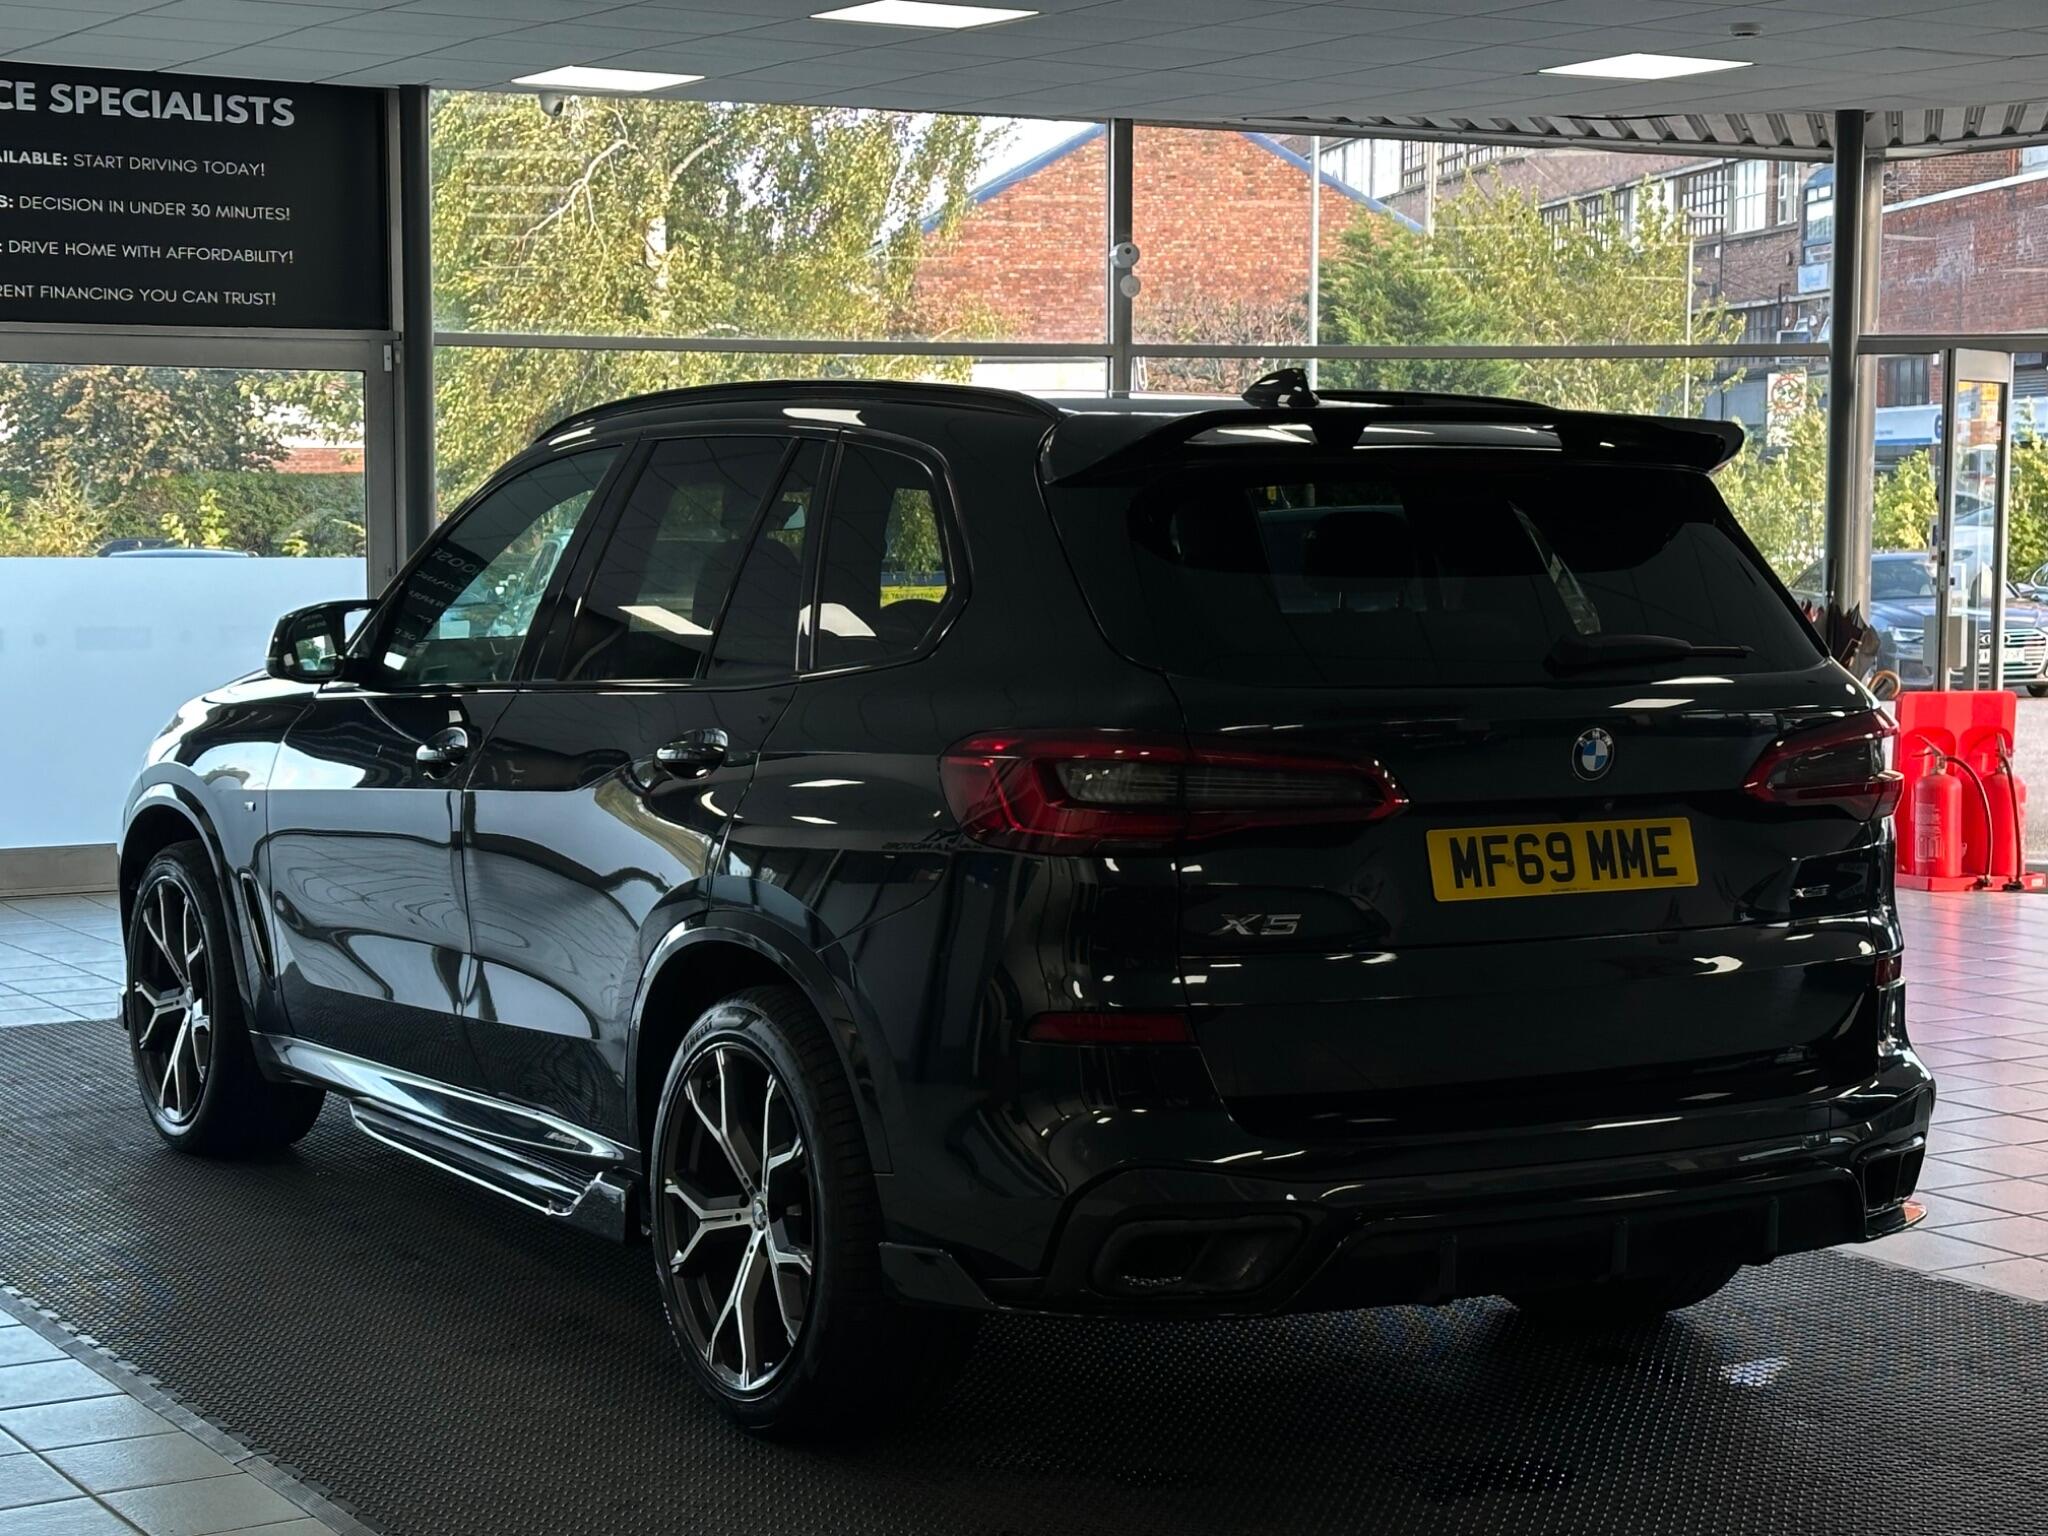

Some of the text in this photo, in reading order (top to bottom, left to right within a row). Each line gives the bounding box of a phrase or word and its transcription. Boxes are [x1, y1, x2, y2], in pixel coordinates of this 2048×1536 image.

[49, 83, 295, 127] SPECIALISTS
[0, 149, 265, 177] ILABLE: START DRIVING TODAY!
[19, 195, 103, 212] DECISION
[109, 200, 124, 214] IN
[129, 201, 186, 217] UNDER
[191, 204, 211, 218] 30
[215, 205, 291, 221] MINUTES!
[8, 239, 294, 264] DRIVE HOME WITH AFFORDABILITY!
[40, 285, 134, 302] FINANCING
[139, 289, 178, 304] YOU
[182, 289, 218, 304] CAN
[223, 291, 276, 307] TRUST!
[1449, 826, 1678, 889] MF69 MME
[1208, 913, 1302, 935] X5
